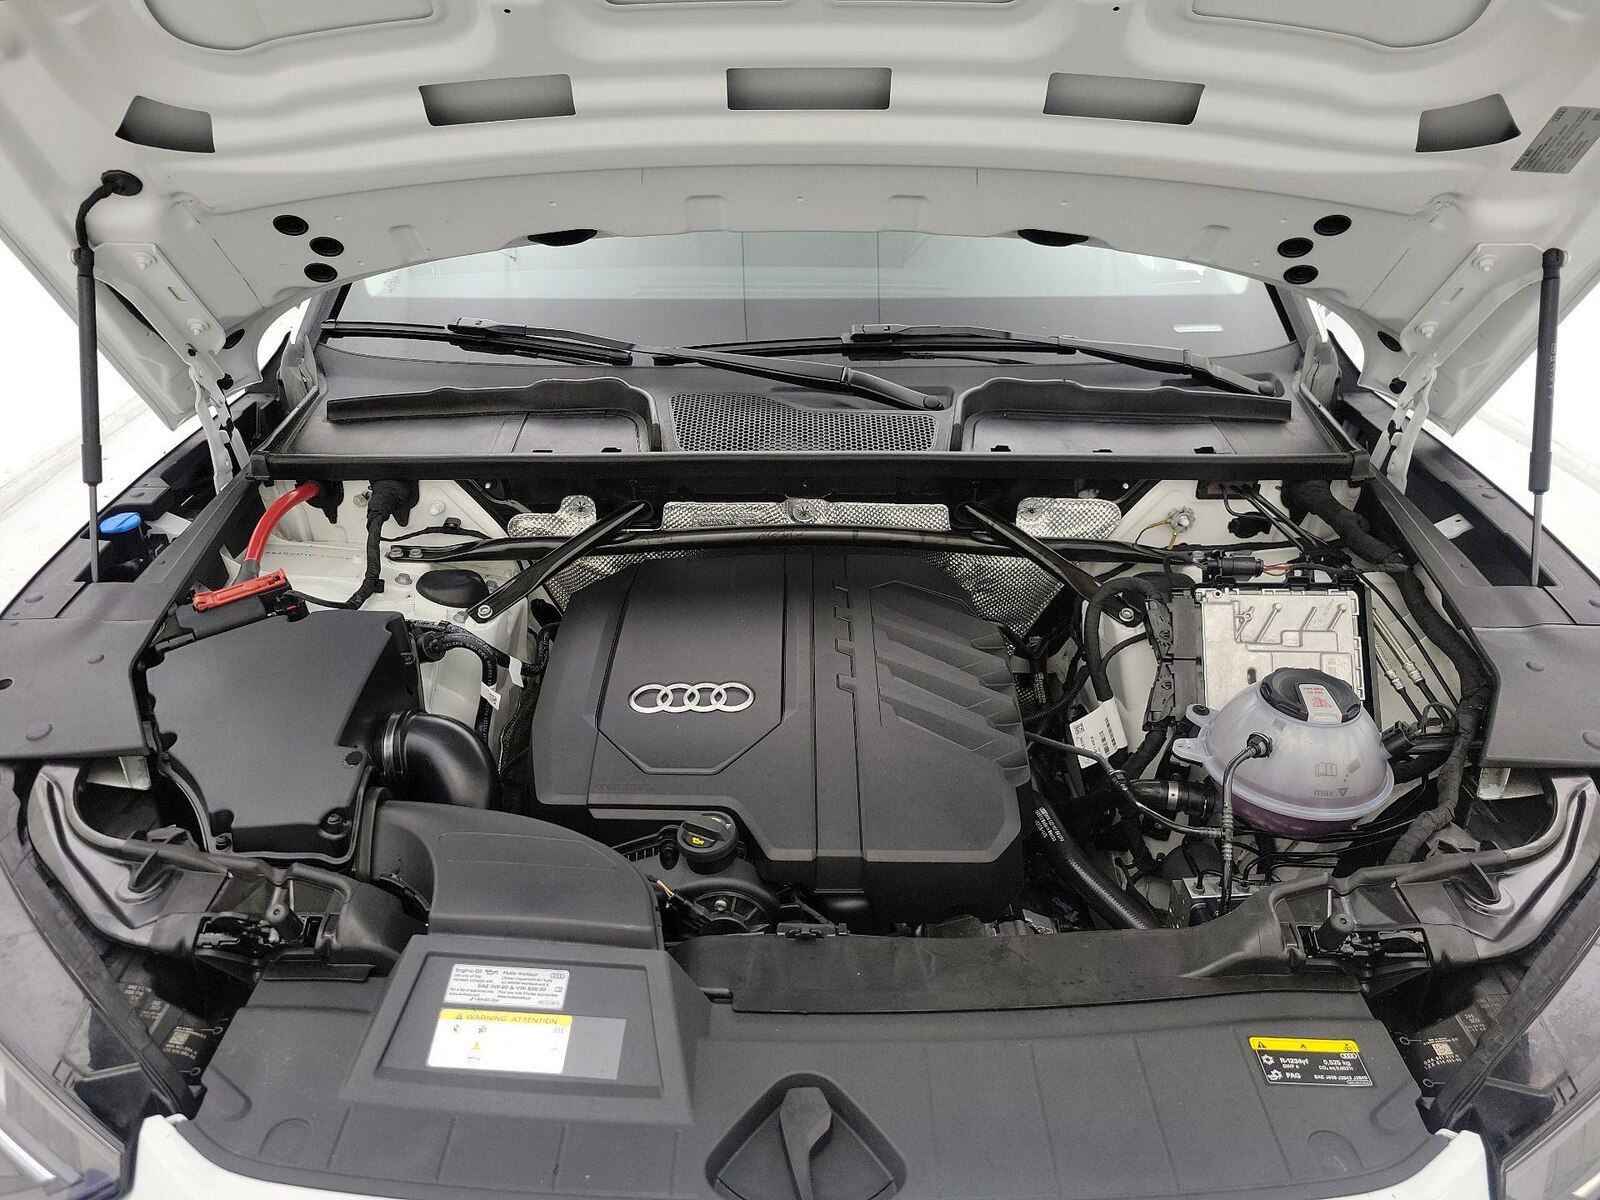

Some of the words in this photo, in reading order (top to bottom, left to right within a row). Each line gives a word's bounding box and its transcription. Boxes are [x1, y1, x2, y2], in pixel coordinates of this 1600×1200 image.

[1313, 788, 1334, 797] max
[466, 1014, 506, 1022] WARNING
[511, 1017, 558, 1025] ATTENTION
[1279, 1057, 1309, 1066] R-1234yf
